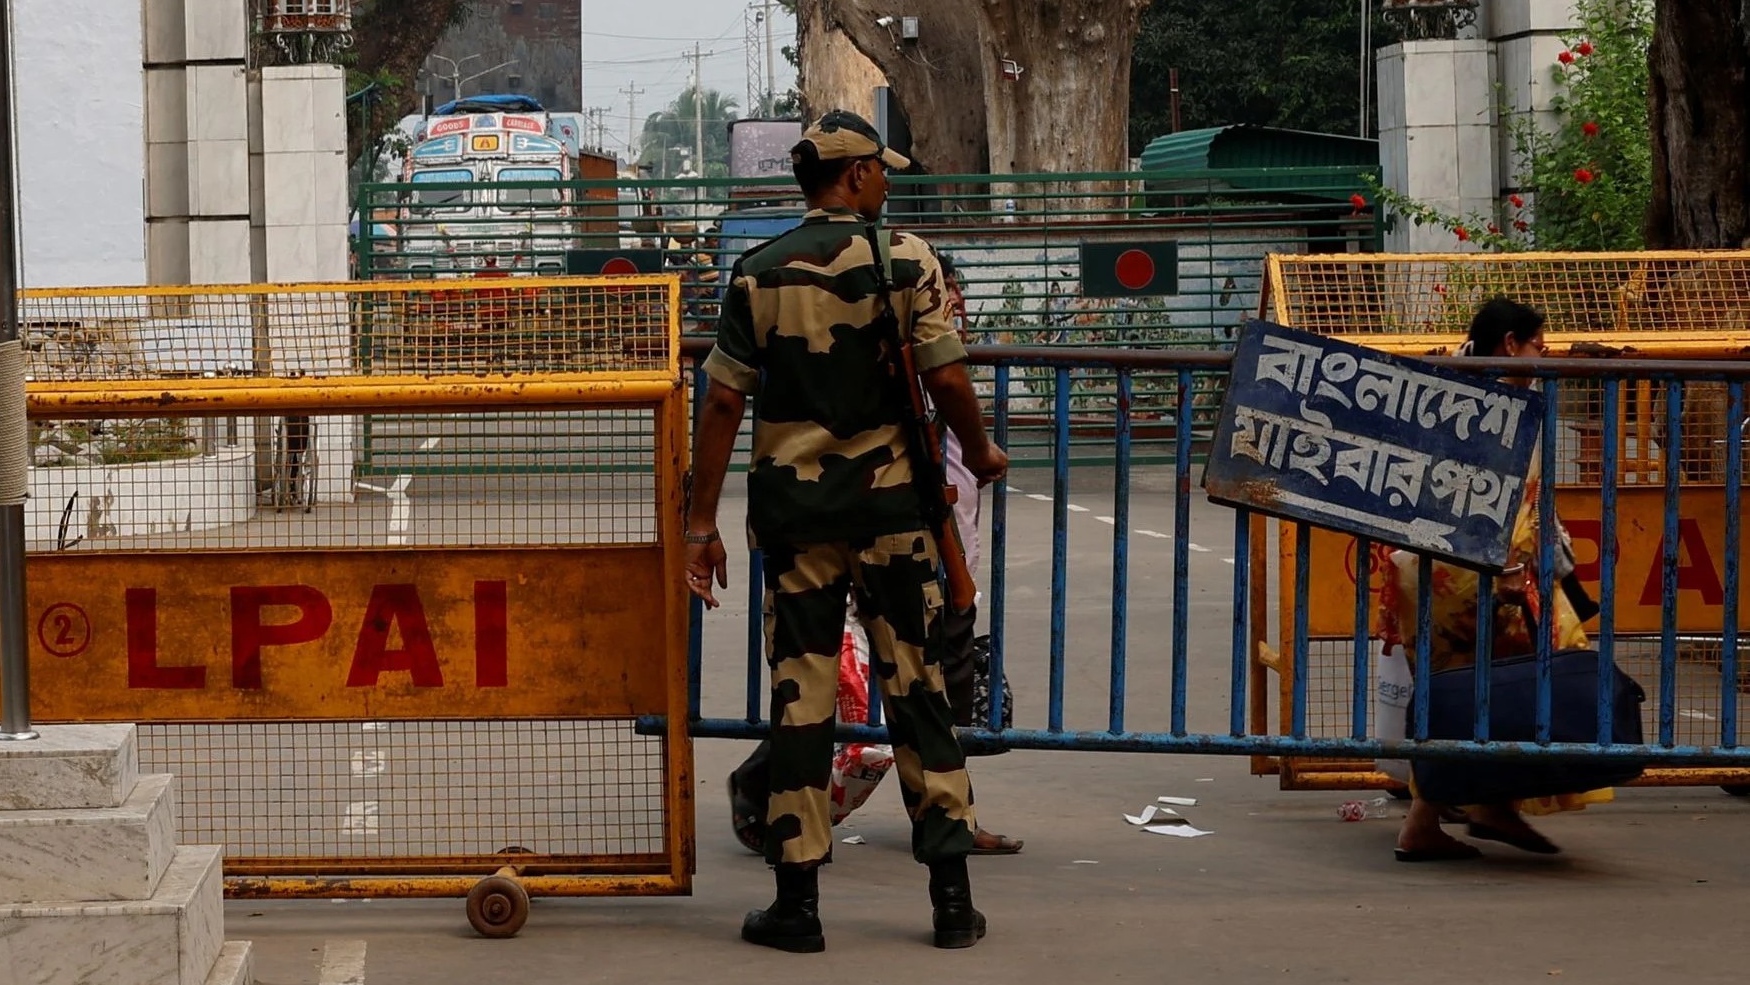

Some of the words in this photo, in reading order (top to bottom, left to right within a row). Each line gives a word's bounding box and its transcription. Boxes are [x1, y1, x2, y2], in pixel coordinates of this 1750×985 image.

[437, 120, 464, 132] GOODS
[1256, 334, 1527, 450] বাংলাদেশ
[54, 615, 75, 645] 2
[125, 580, 508, 689] LPAI
